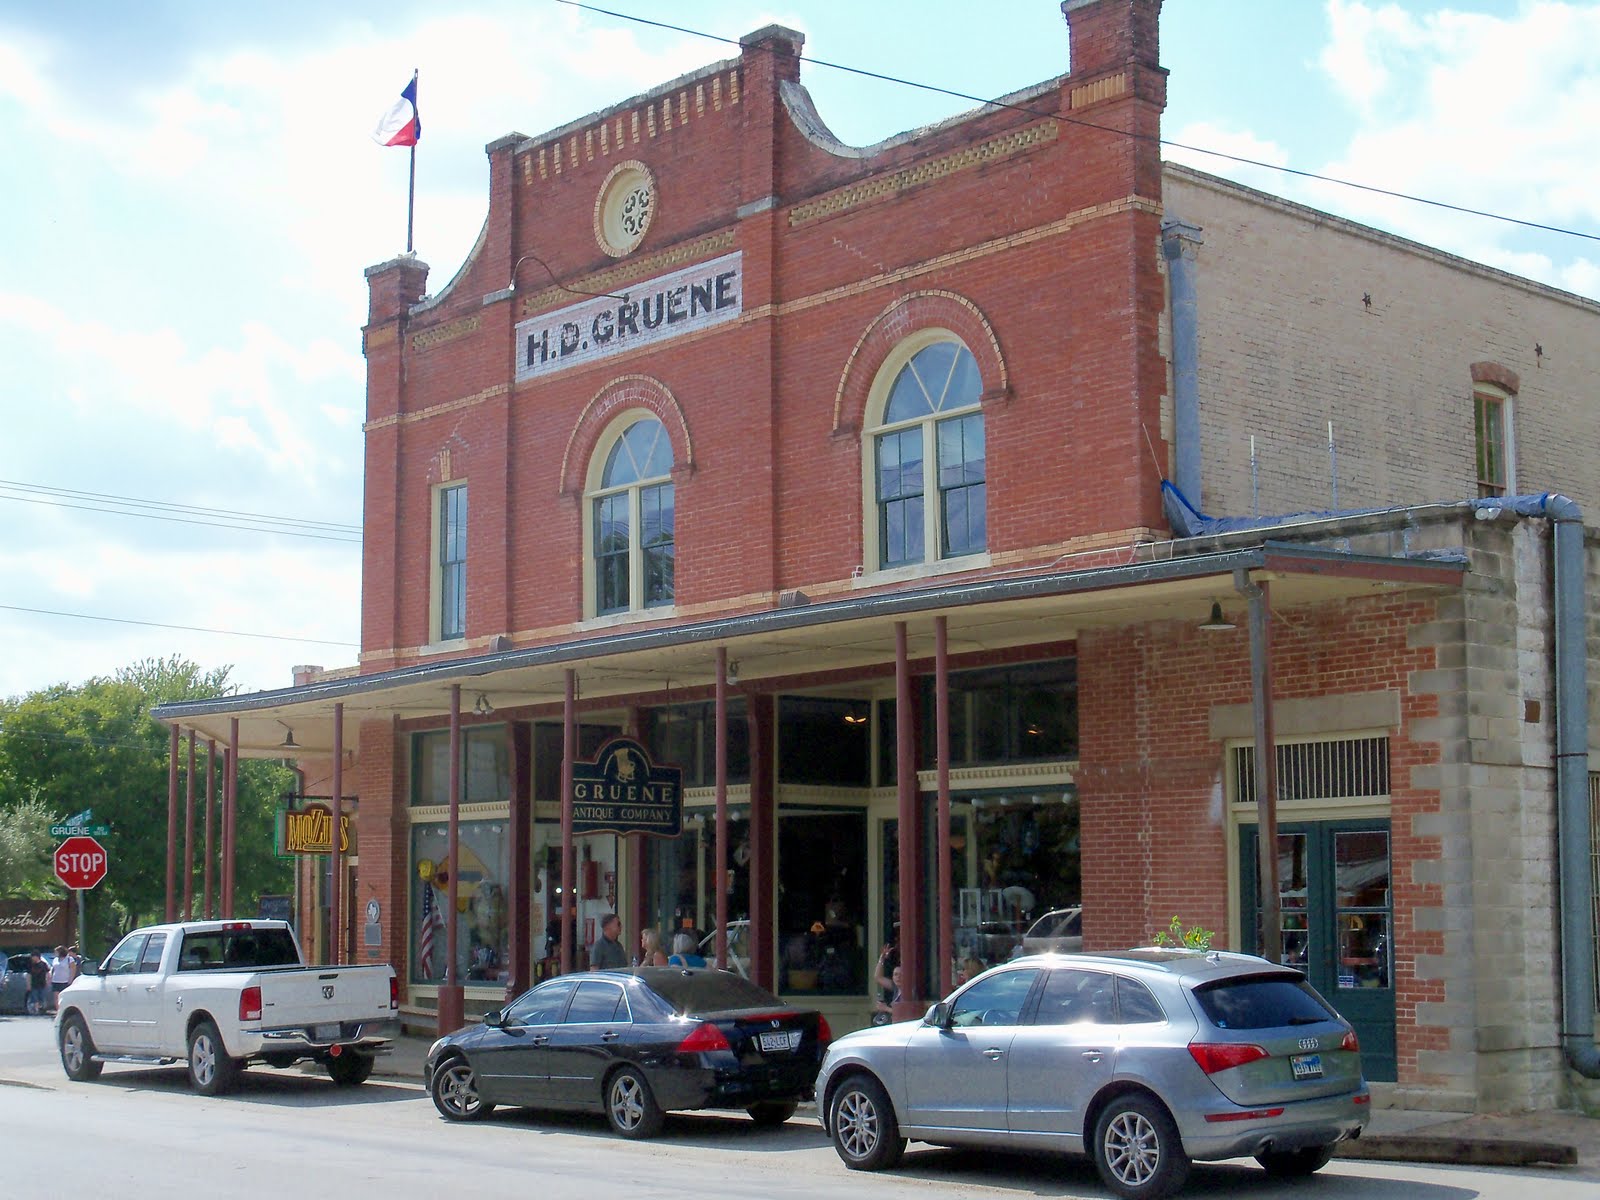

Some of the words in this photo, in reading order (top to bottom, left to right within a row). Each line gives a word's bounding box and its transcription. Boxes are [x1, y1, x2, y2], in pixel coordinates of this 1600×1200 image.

[526, 322, 588, 366] H.D.
[591, 270, 737, 344] GRUENE
[574, 784, 673, 801] GRUENE
[572, 807, 614, 820] ANTIQUE
[620, 808, 673, 821] COMPANY
[51, 826, 90, 835] GRUENE
[58, 853, 104, 873] STOP
[0, 906, 60, 927] ristmill
